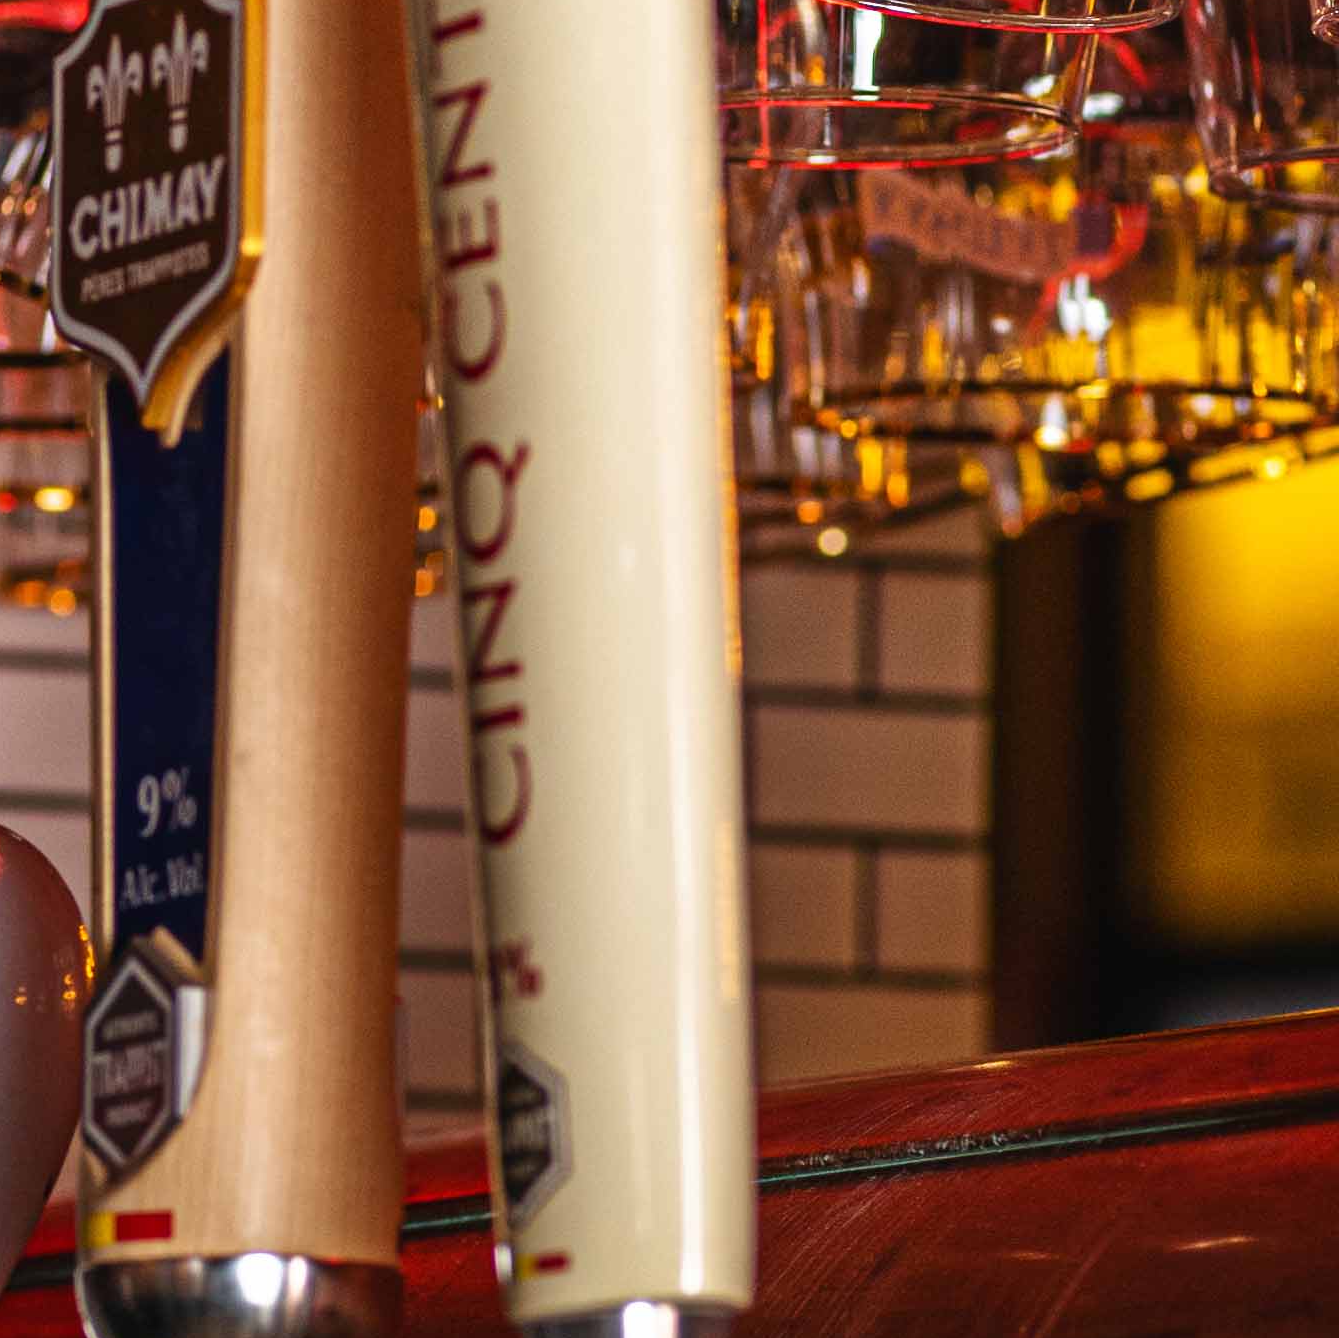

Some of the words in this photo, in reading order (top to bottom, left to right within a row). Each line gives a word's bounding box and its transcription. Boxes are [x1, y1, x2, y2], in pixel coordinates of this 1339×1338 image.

[69, 156, 224, 260] CHIMAY
[454, 440, 533, 848] CINQ
[136, 766, 197, 838] 9%
